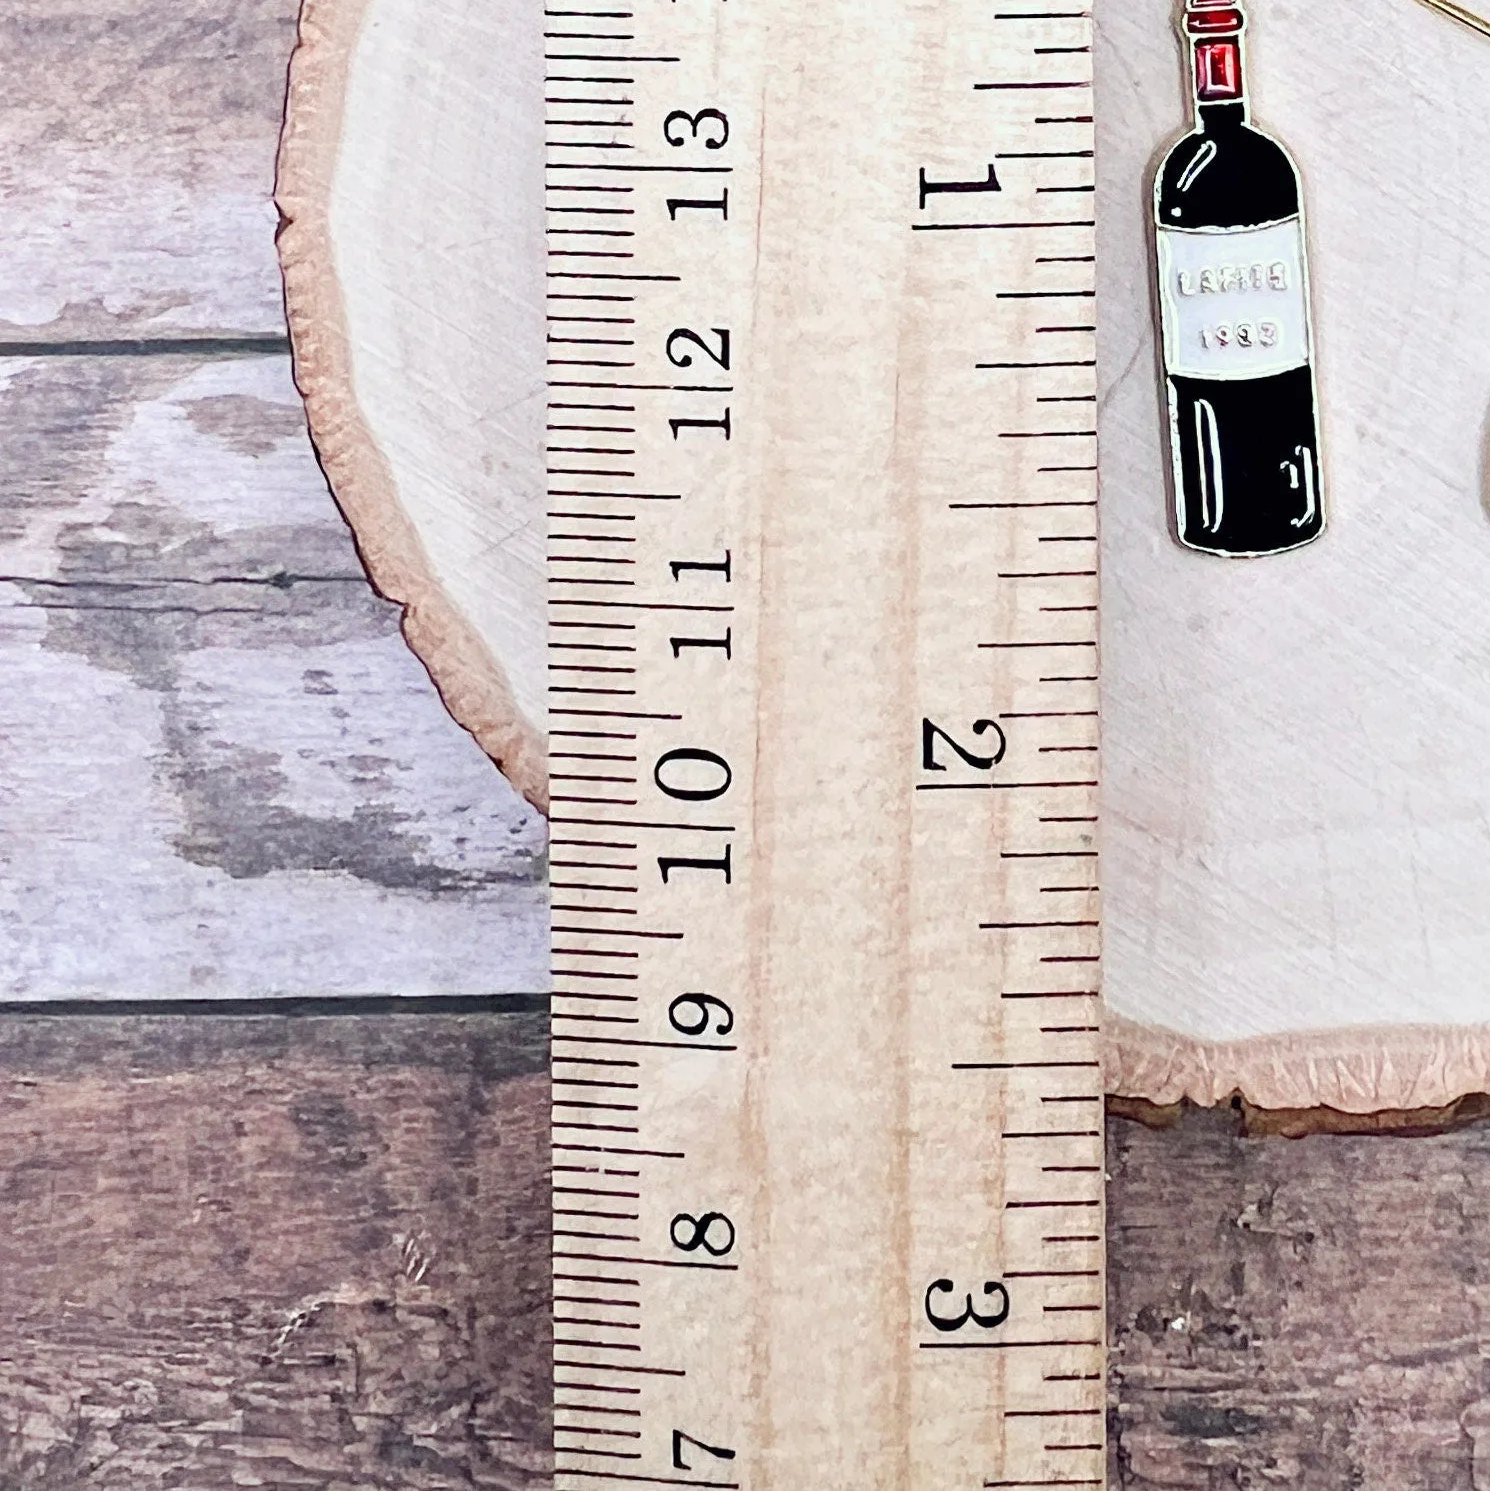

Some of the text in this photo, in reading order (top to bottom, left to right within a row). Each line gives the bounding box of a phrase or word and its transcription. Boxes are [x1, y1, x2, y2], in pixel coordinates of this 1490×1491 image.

[662, 107, 729, 221] 13
[919, 163, 1002, 210] 1
[665, 326, 731, 441] 12
[668, 549, 732, 661] 11
[922, 717, 1007, 772] 2
[653, 747, 732, 885] 10
[668, 992, 734, 1037] 9
[669, 1211, 736, 1257] 8
[924, 1278, 1010, 1332] 3
[672, 1429, 737, 1471] 7
